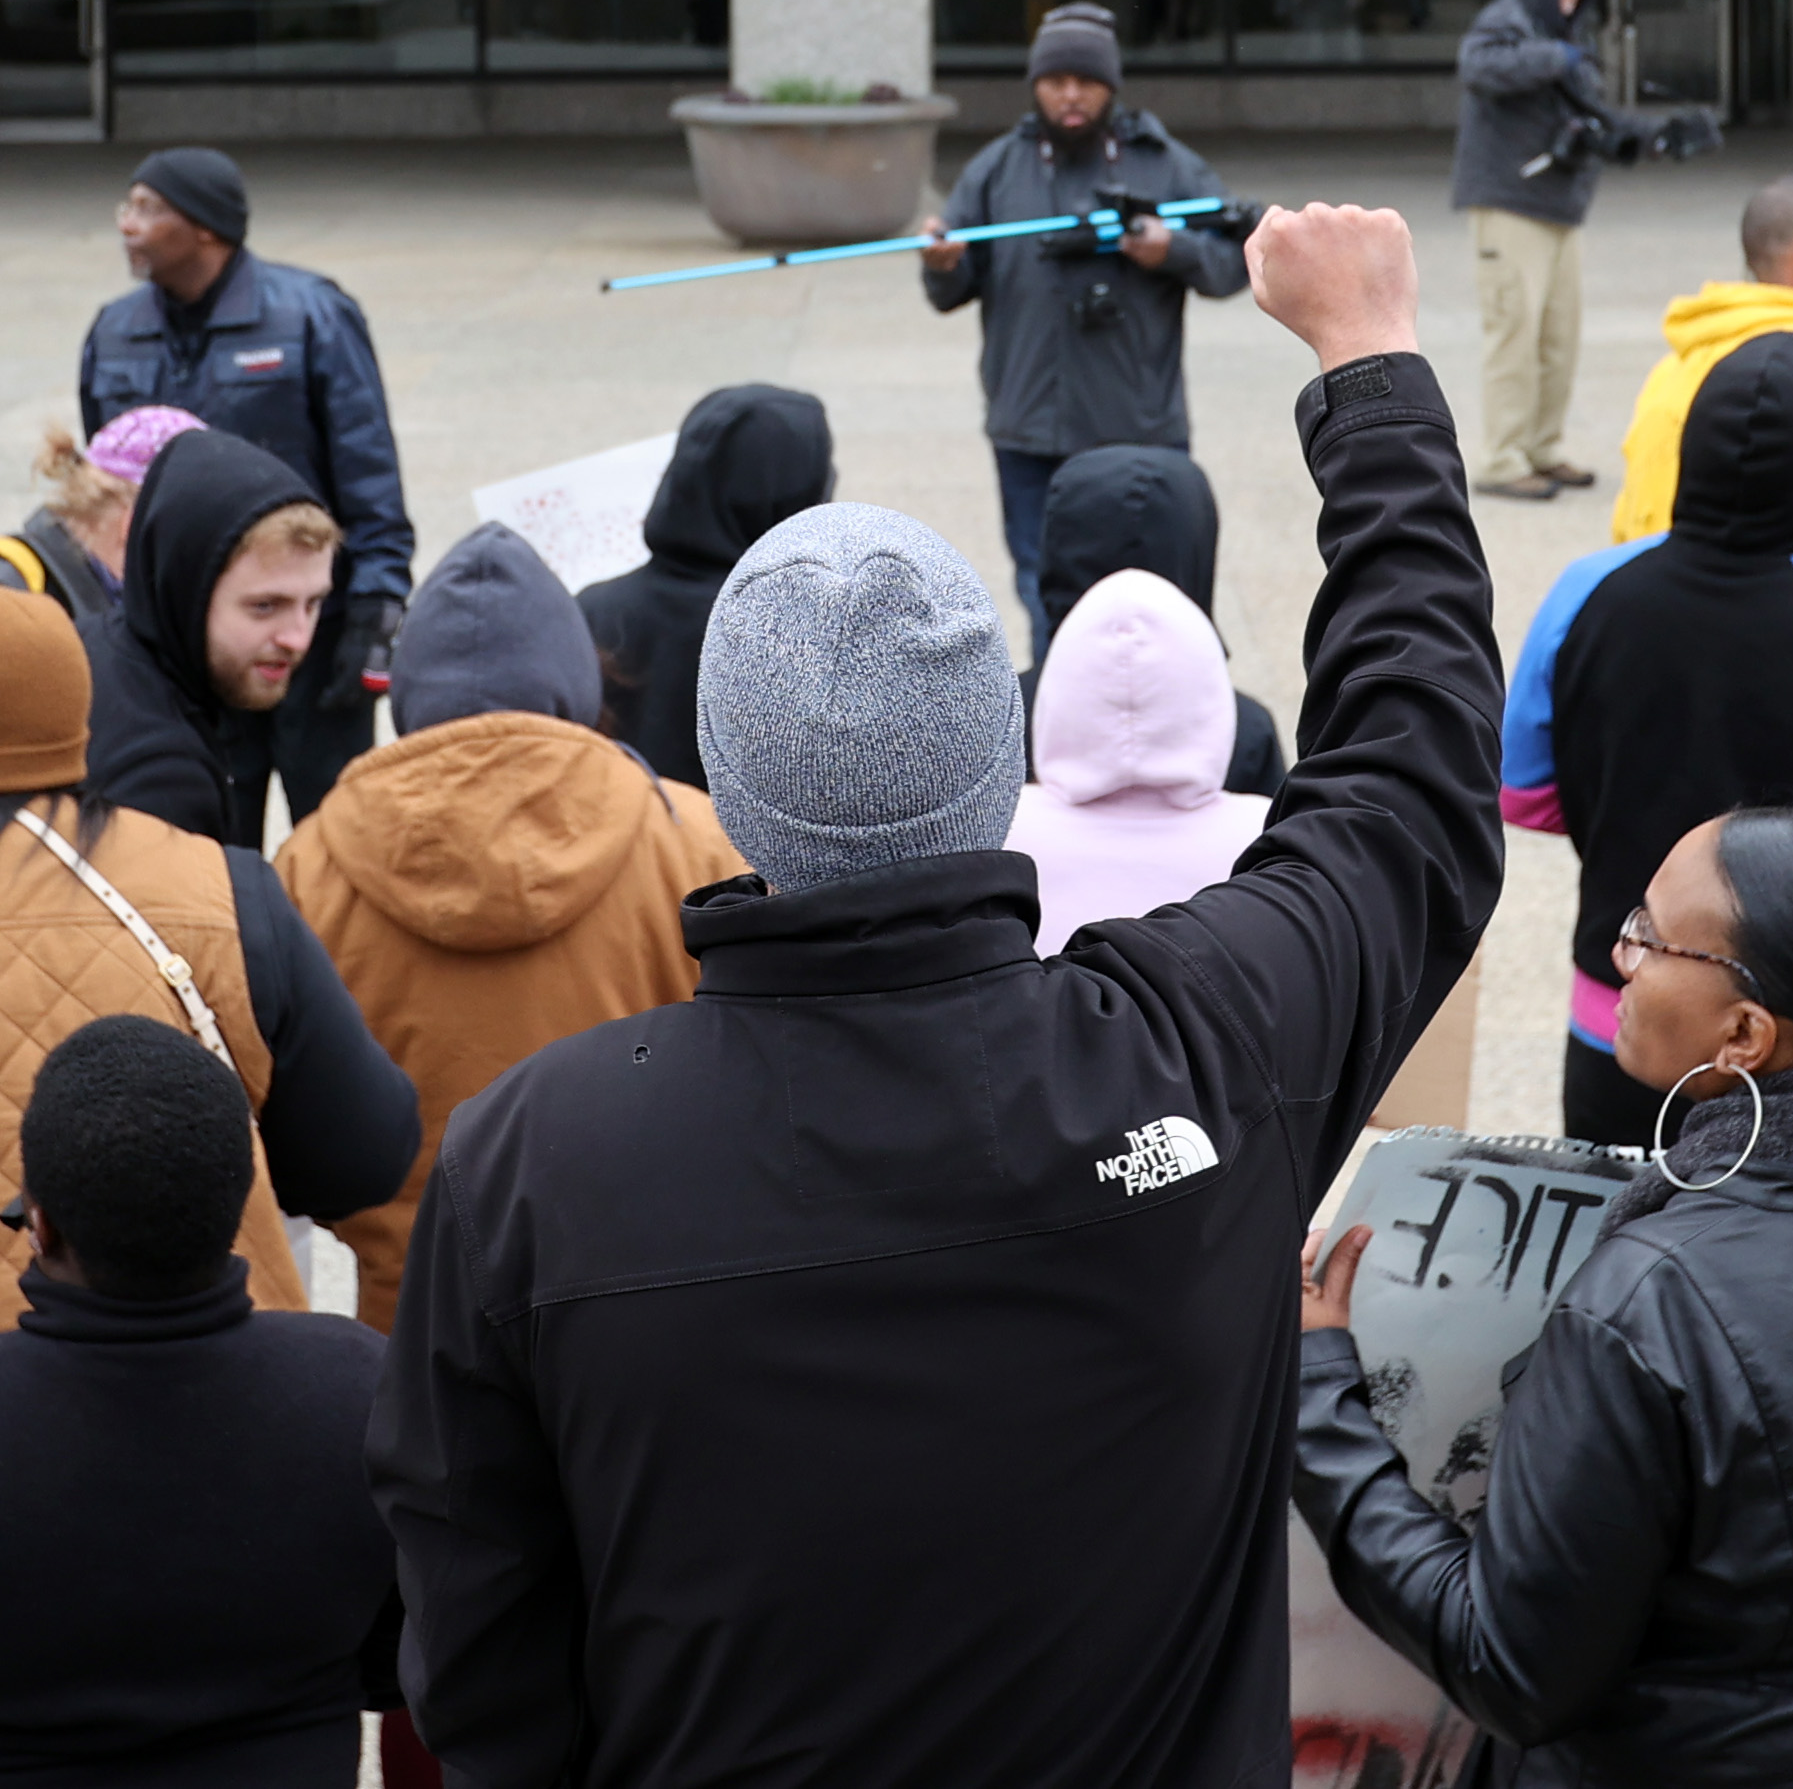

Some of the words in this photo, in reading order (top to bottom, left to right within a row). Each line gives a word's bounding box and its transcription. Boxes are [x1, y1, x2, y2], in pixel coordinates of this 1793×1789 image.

[1124, 1120, 1169, 1152] THE
[1095, 1138, 1177, 1183] NORTH
[1124, 1158, 1183, 1197] FACE
